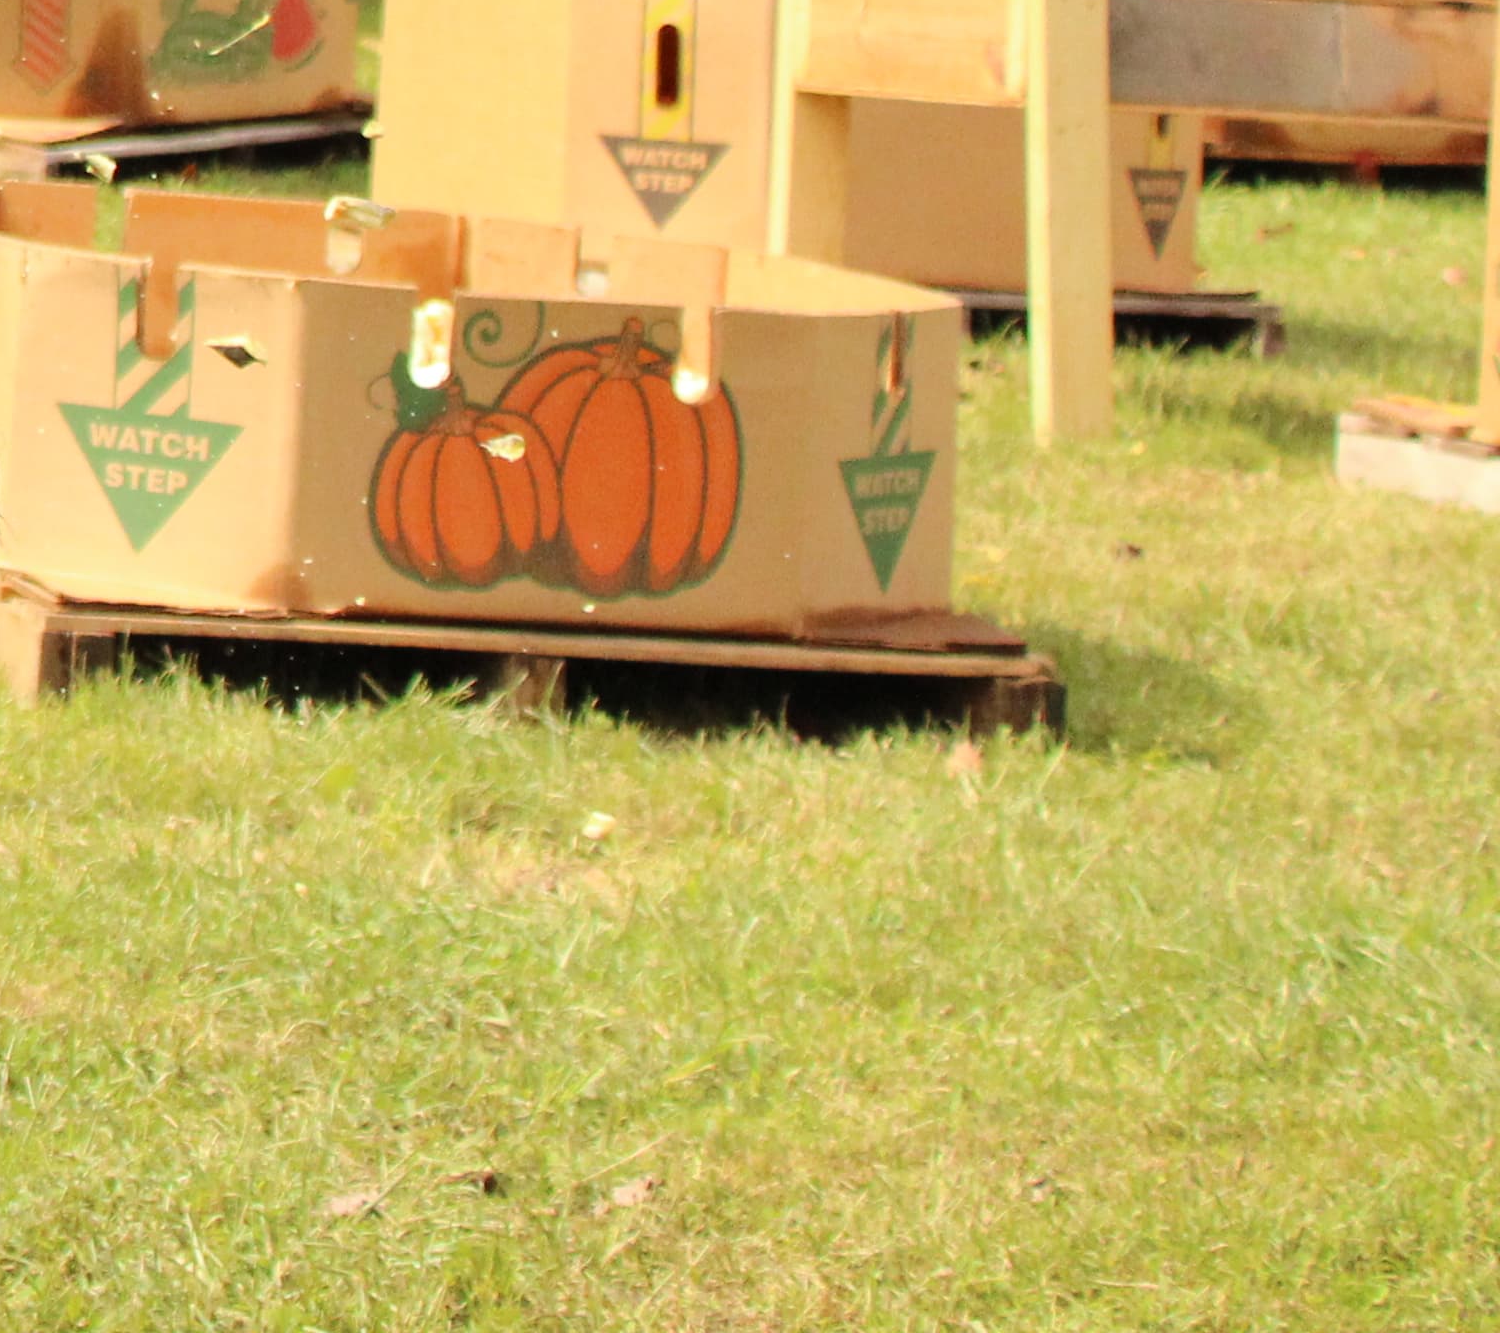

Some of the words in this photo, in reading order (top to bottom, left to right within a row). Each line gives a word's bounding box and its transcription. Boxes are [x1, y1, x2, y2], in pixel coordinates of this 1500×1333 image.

[620, 147, 709, 171] WATCH
[634, 172, 695, 194] STEP
[89, 423, 210, 461] WATCH
[105, 463, 188, 494] STEP
